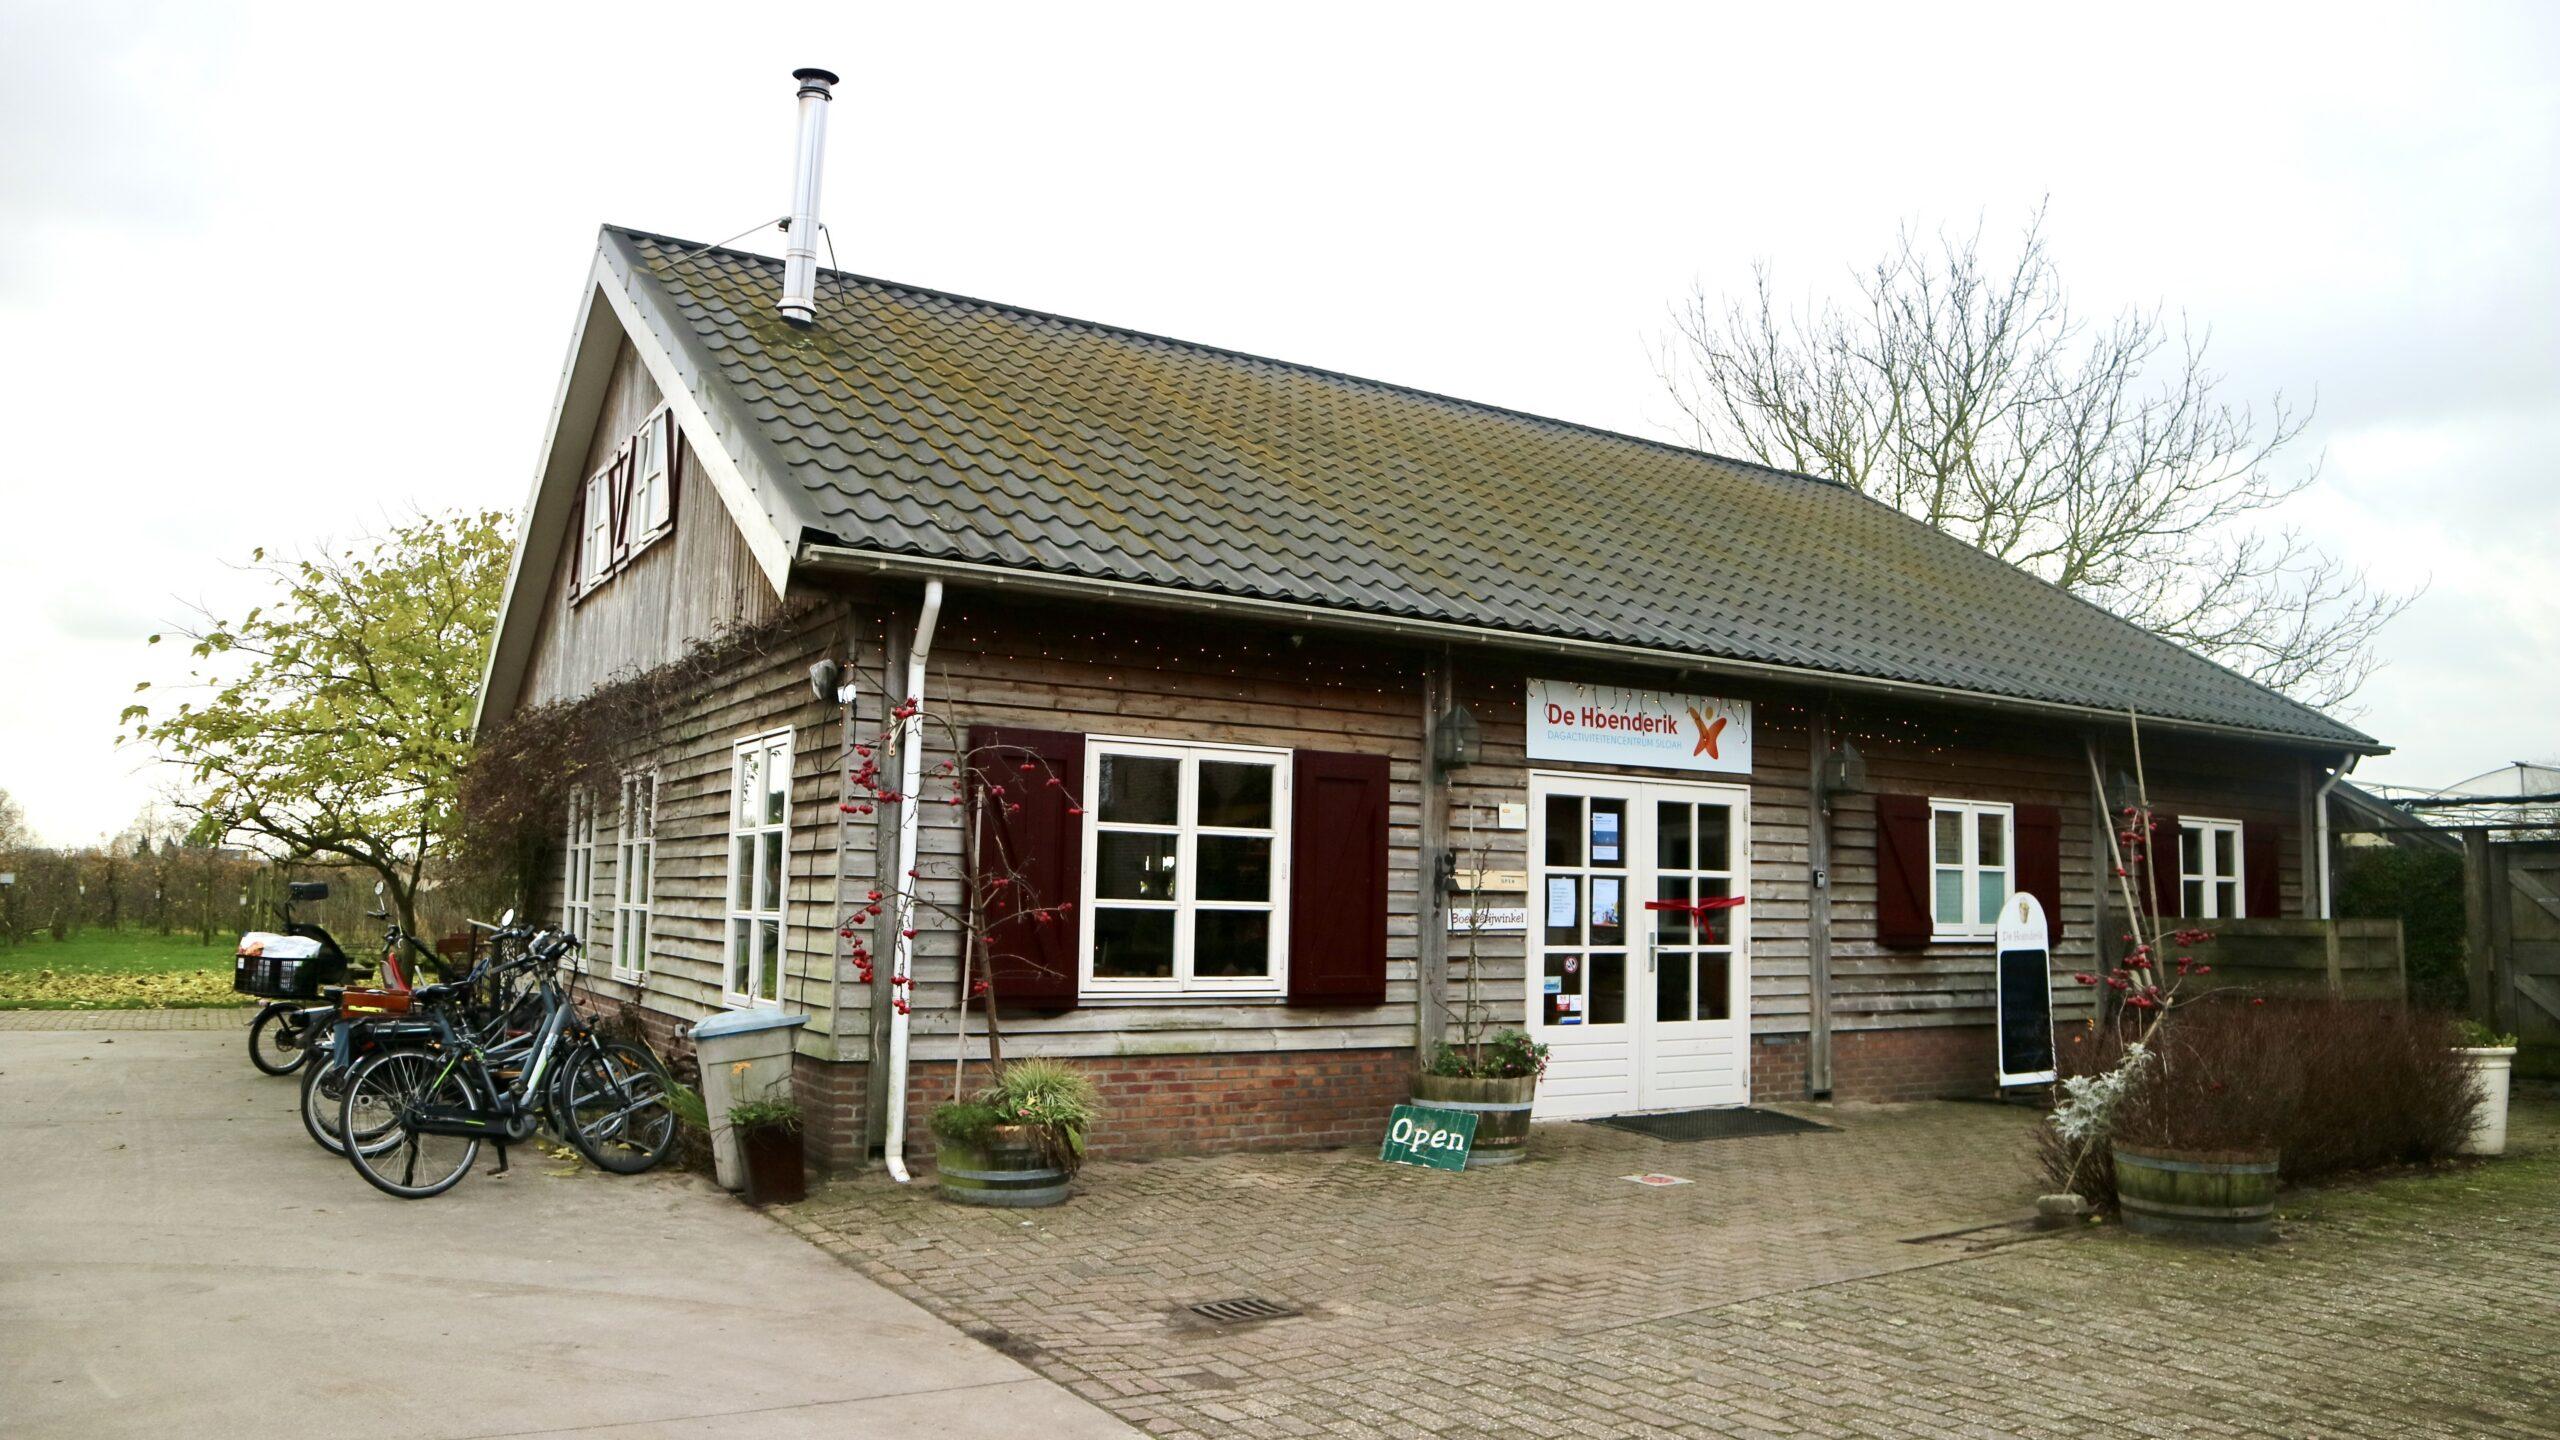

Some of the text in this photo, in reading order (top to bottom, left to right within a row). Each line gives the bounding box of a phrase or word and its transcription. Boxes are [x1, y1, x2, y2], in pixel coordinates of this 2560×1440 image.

[1548, 703, 1678, 734] De Hoenderik
[1392, 1117, 1464, 1153] Open
